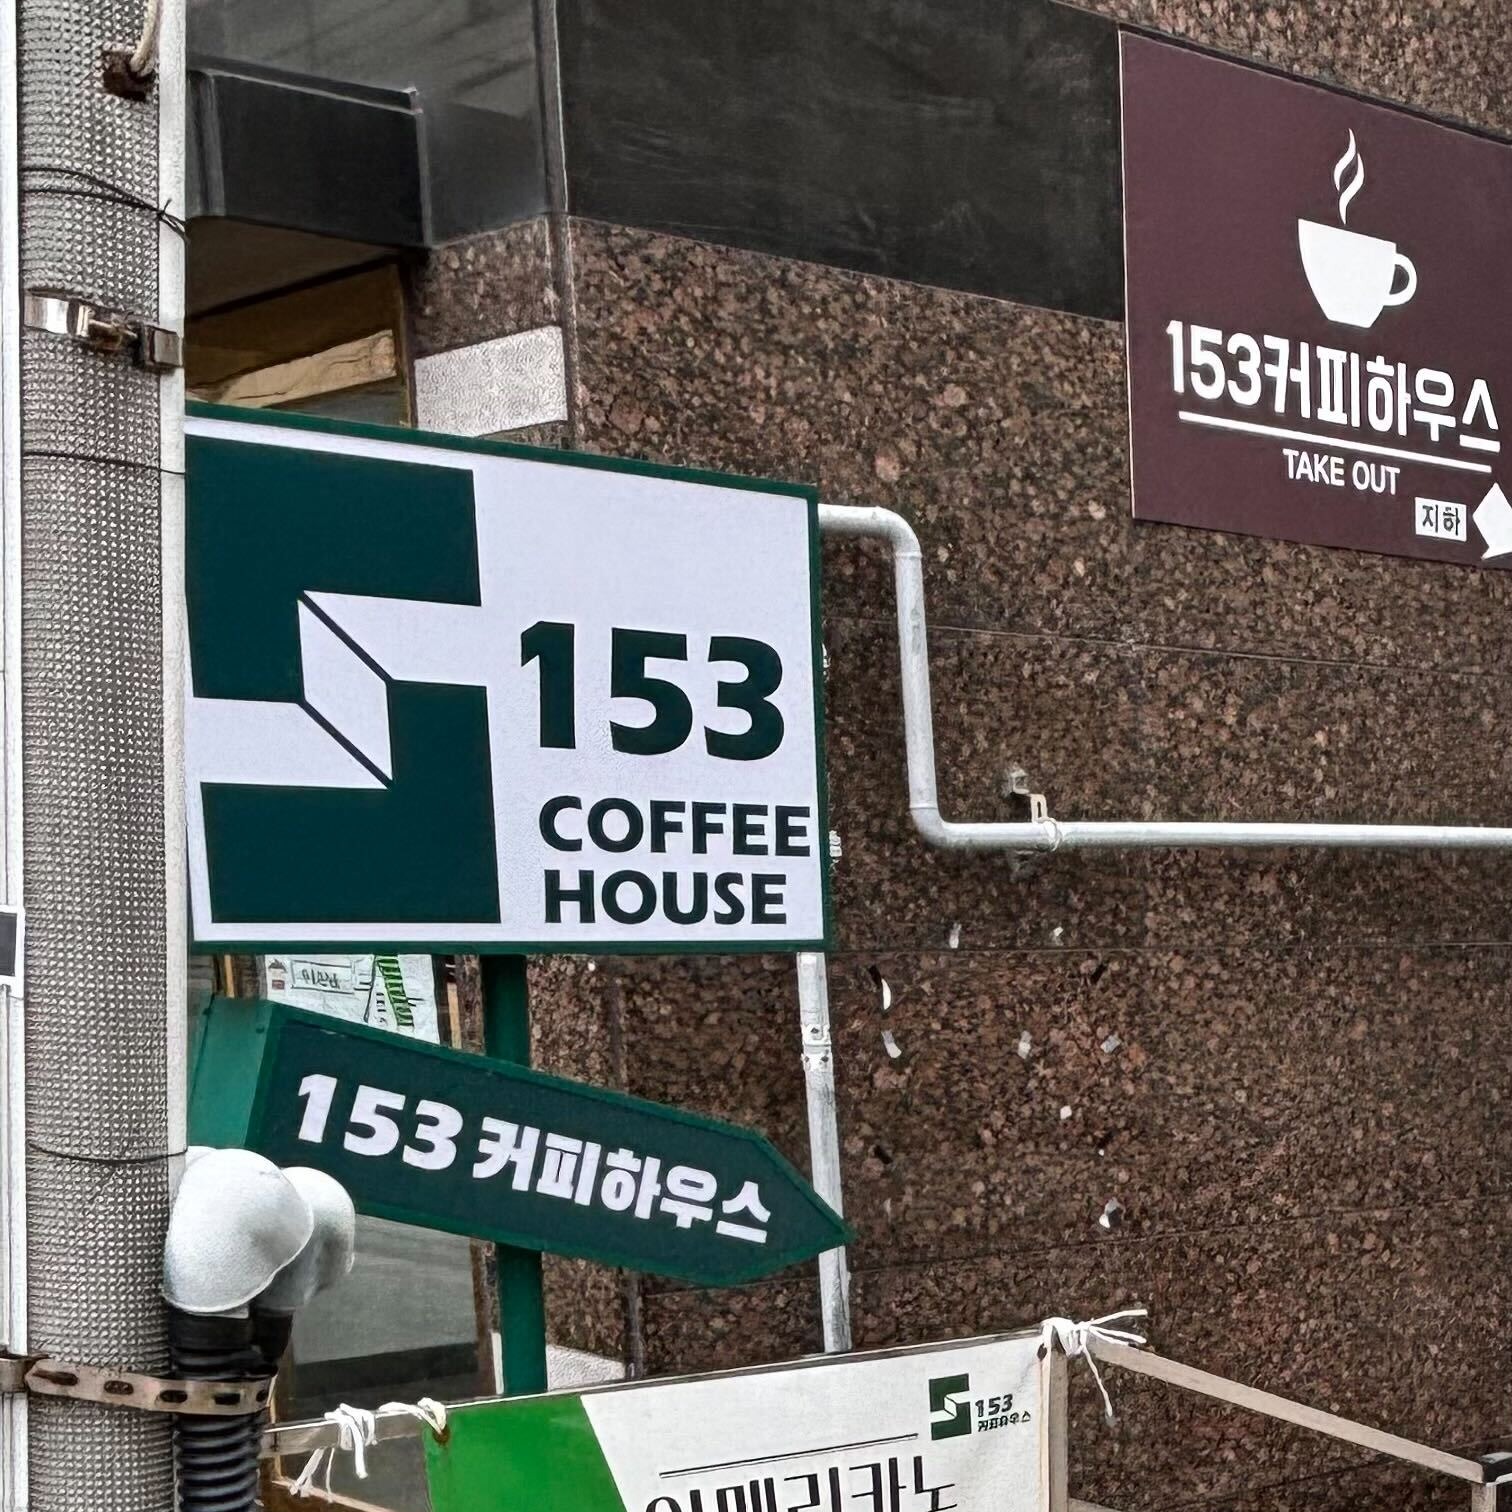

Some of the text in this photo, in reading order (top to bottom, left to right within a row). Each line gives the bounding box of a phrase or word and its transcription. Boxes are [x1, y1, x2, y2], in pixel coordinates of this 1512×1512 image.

[1165, 320, 1500, 452] 153커피하우스
[1282, 449, 1400, 496] TAKE OUT
[1421, 503, 1461, 537] 지하
[520, 620, 785, 762] 153
[538, 795, 811, 858] COFFEE
[544, 869, 788, 926] HOUSE
[297, 1073, 771, 1244] 153 커피하우스
[975, 1393, 1014, 1418] 153
[977, 1410, 1032, 1433] 커피하우스
